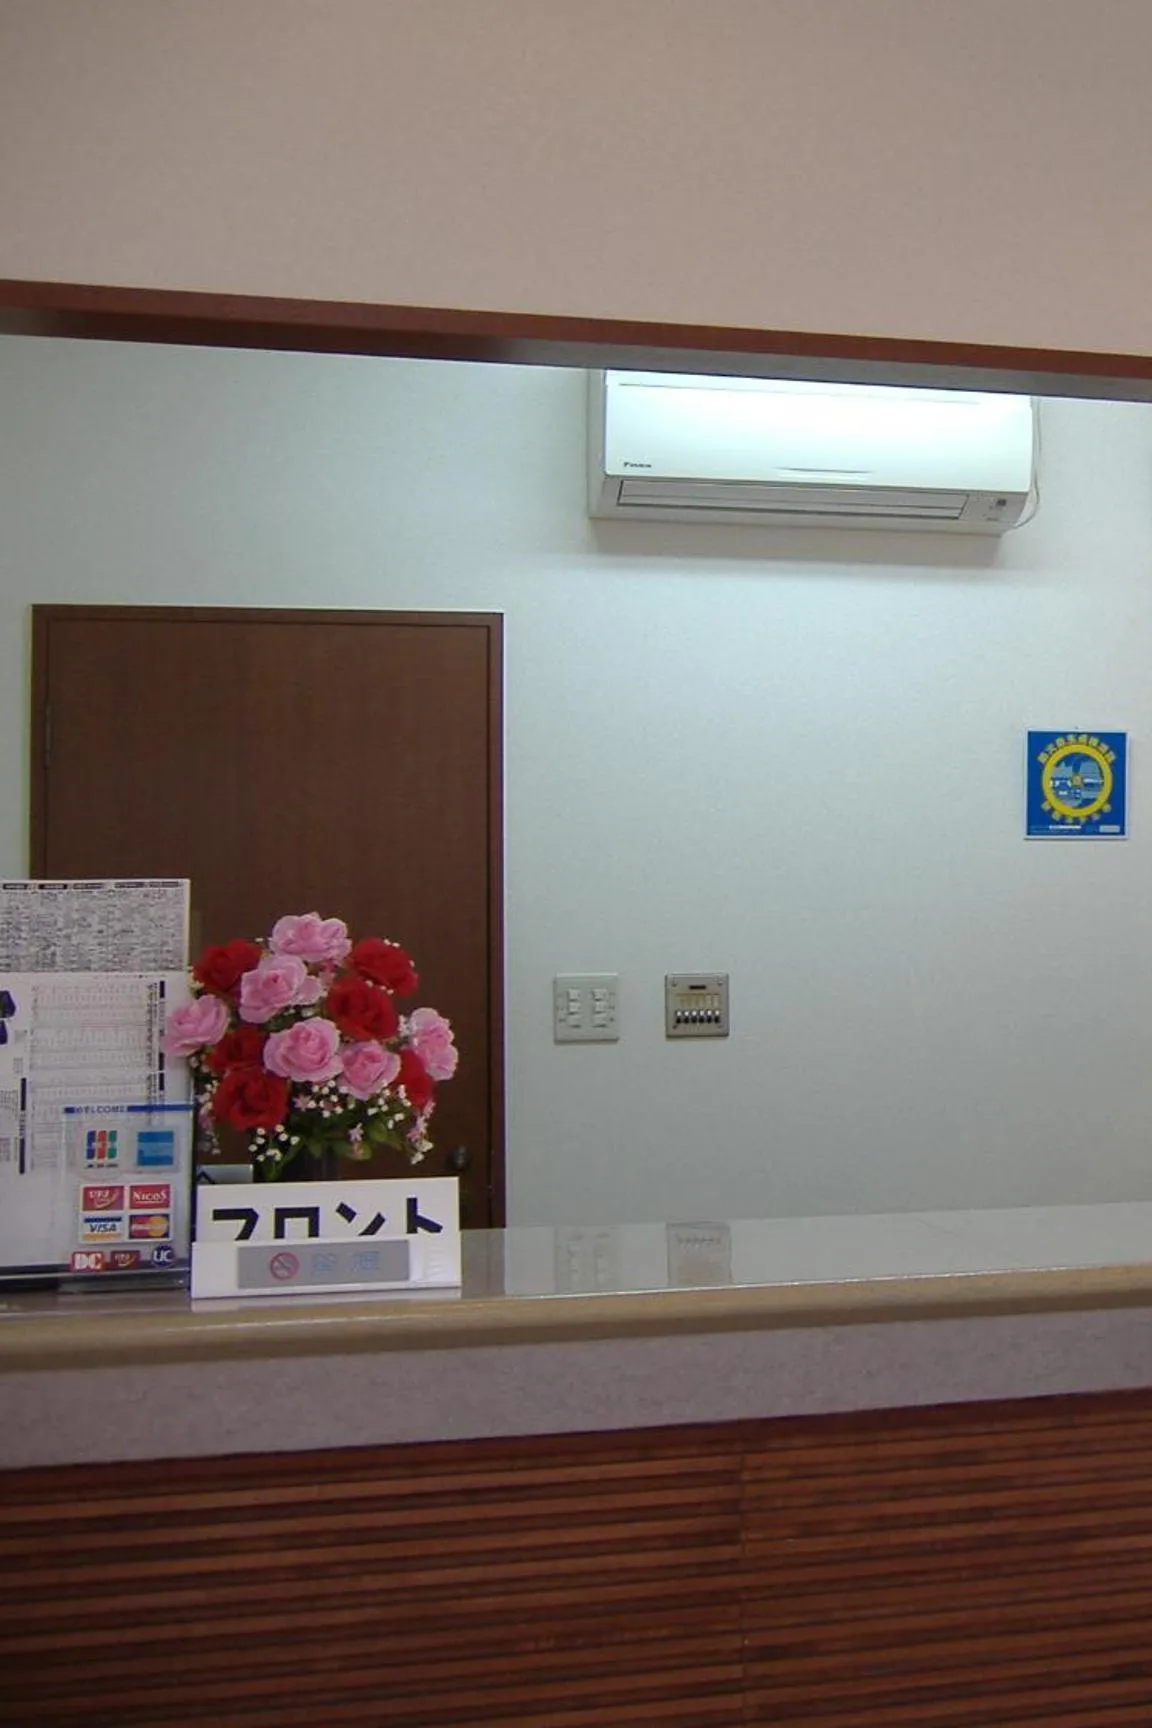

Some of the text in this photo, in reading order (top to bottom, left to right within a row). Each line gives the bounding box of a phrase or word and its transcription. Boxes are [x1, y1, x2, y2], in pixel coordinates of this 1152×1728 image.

[88, 1223, 117, 1233] VISA
[73, 1252, 103, 1270] DC
[153, 1250, 173, 1263] UC
